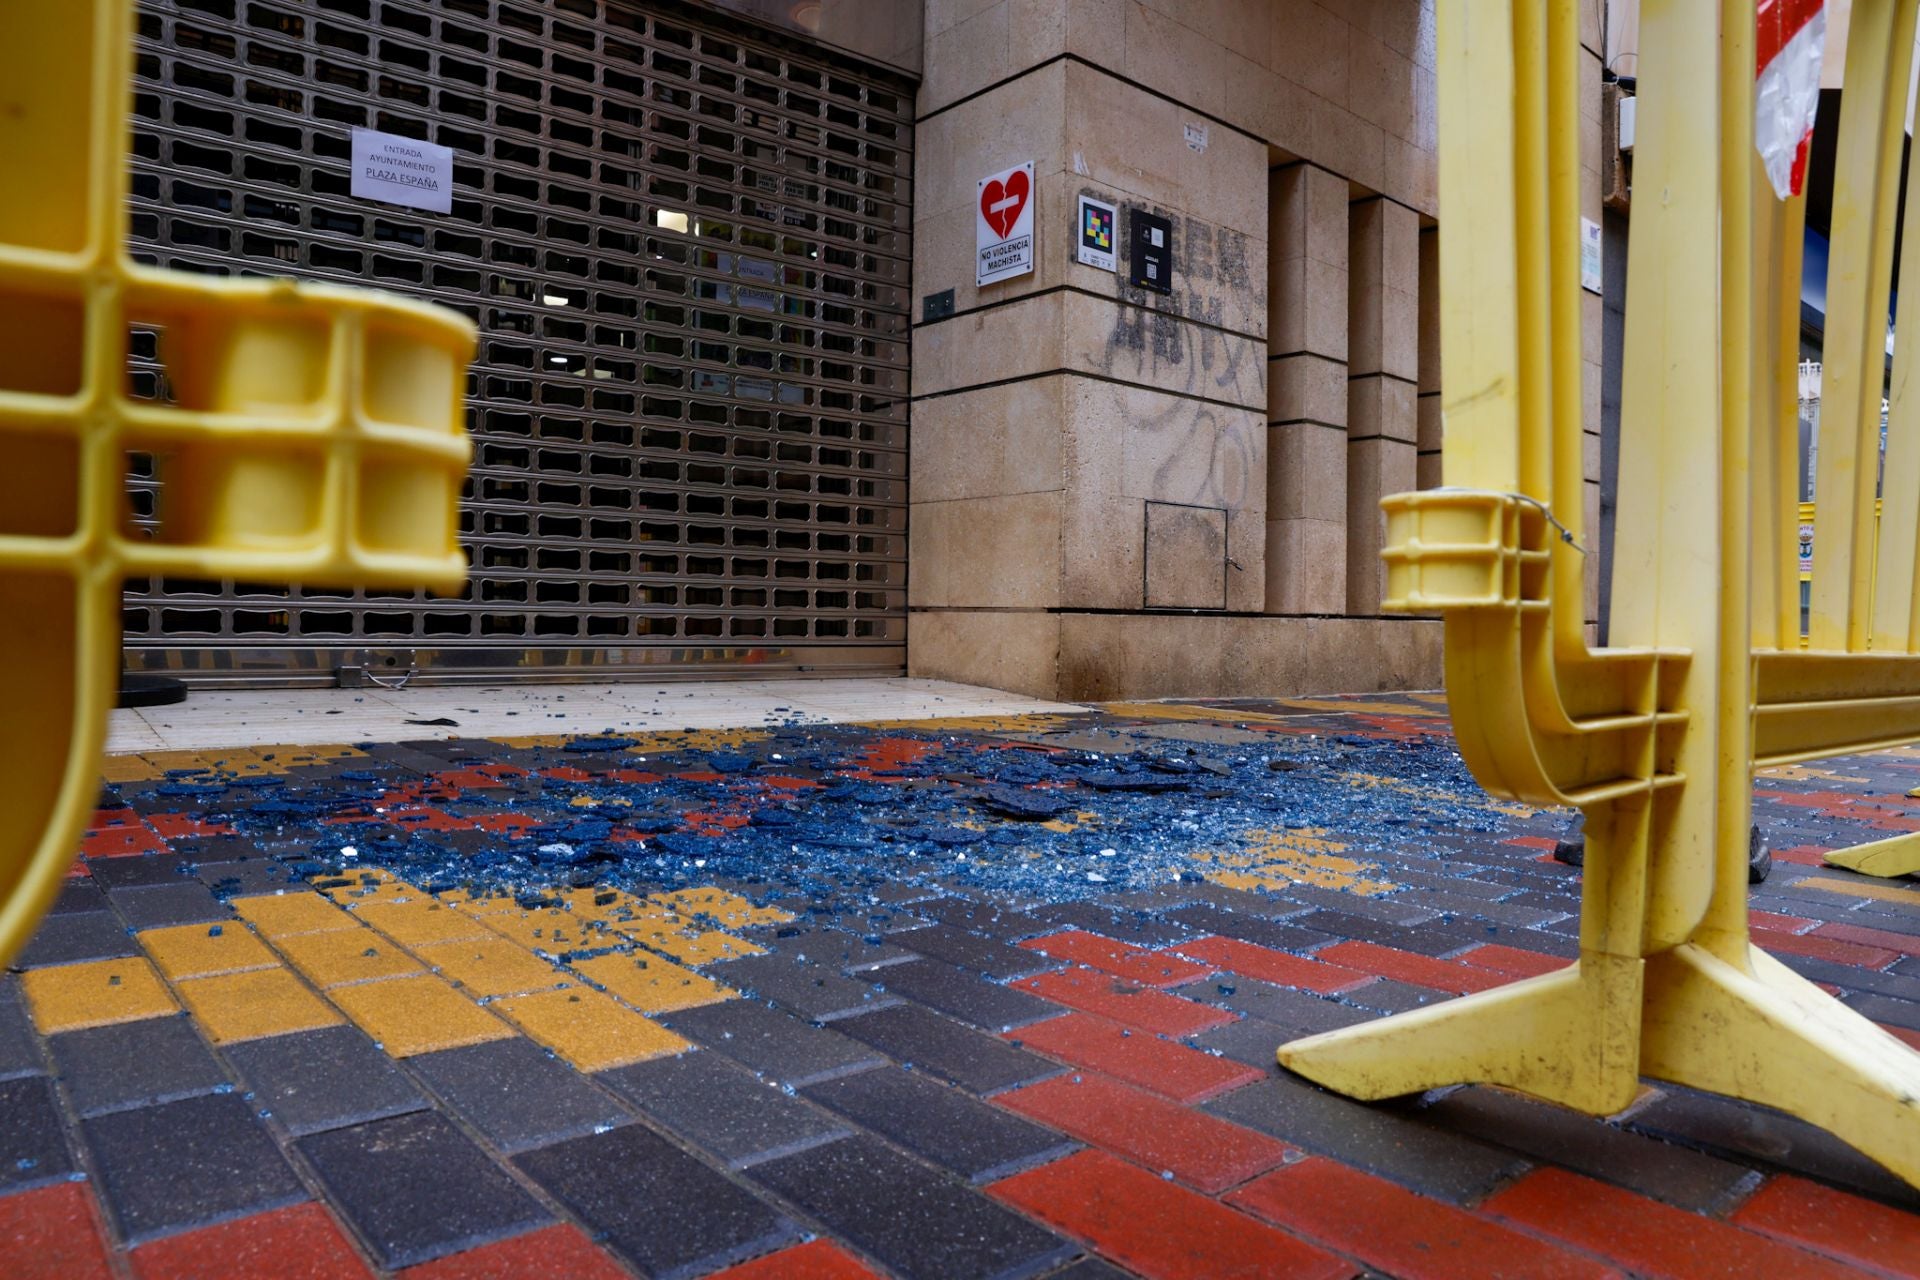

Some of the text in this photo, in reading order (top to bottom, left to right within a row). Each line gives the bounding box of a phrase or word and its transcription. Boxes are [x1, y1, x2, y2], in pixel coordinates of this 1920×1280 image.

[383, 144, 423, 159] ENTRADA
[369, 154, 436, 174] AYUNTAMIENTO
[365, 167, 439, 190] PLAZA ESPAÑA
[981, 239, 1029, 260] NO VIOLENCIA
[987, 253, 1022, 271] MACHISTA
